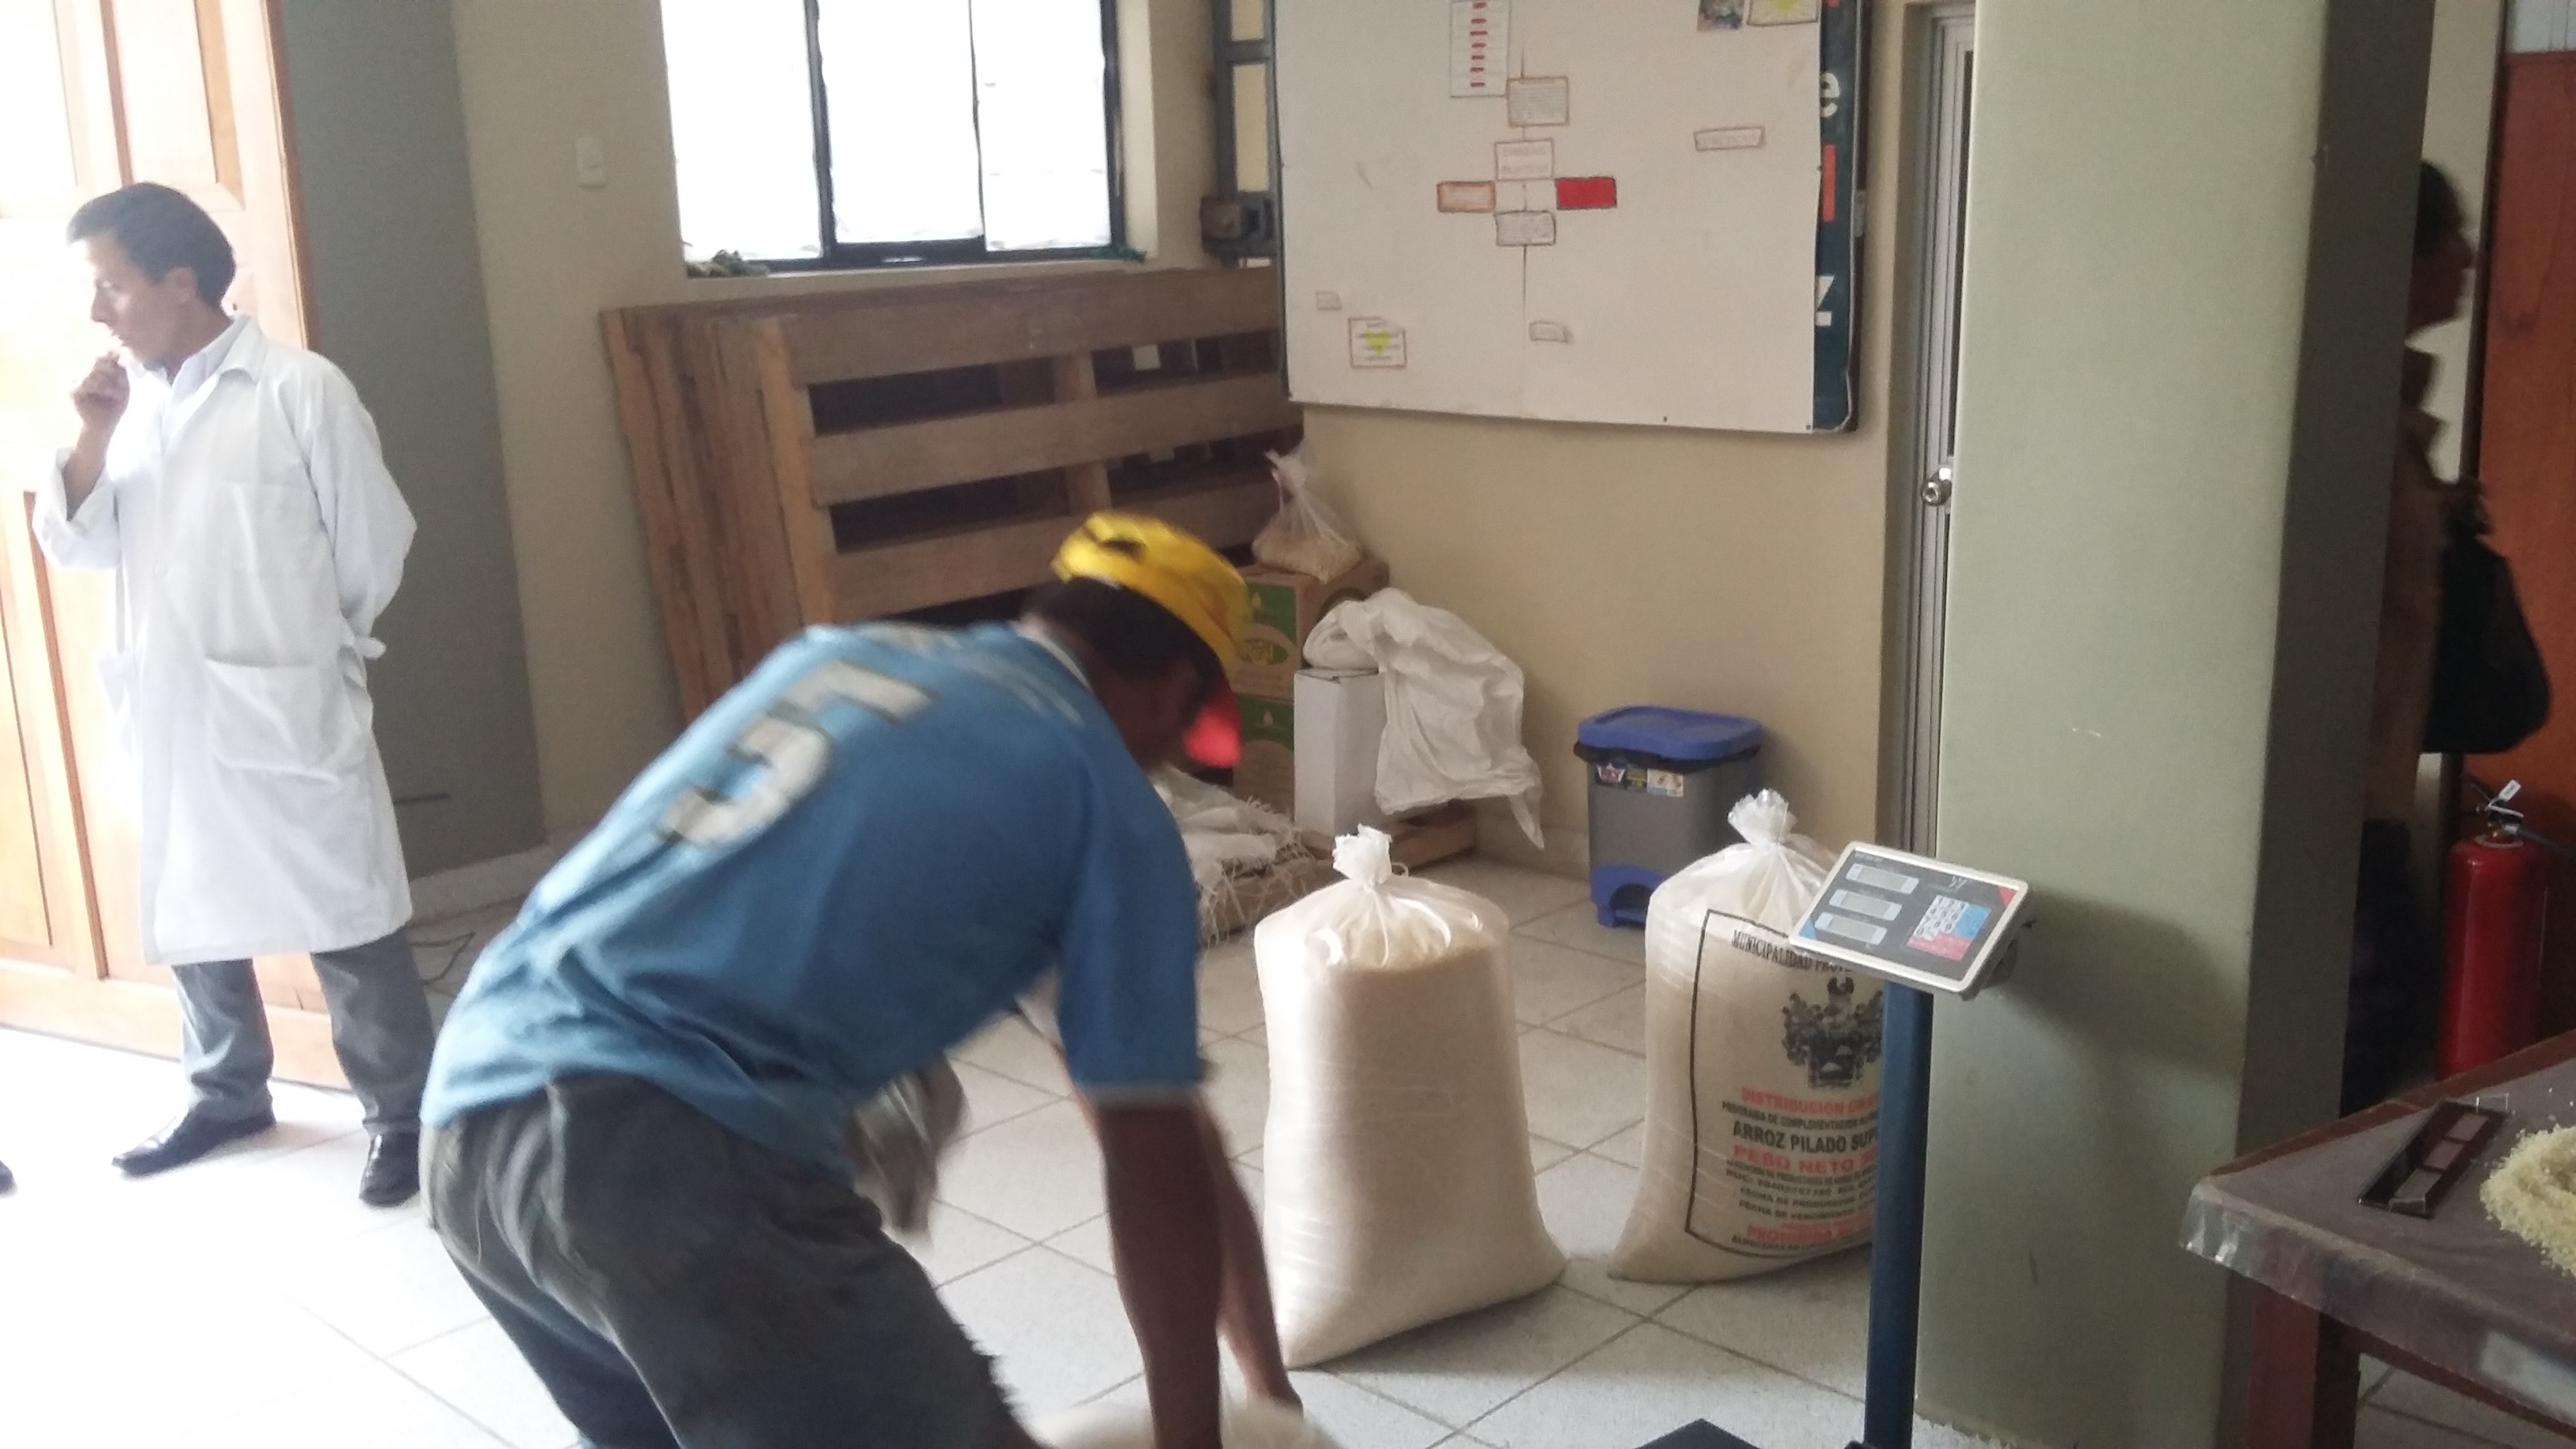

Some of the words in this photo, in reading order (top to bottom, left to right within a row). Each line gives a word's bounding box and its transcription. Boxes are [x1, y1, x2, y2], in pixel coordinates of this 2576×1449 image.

[1733, 1120, 1786, 1150] ARROZ
[1790, 1133, 1847, 1154] PILADO
[1734, 1144, 1791, 1170] PESO
[1799, 1158, 1854, 1175] NETO
[1739, 1200, 1772, 1216] FECHA
